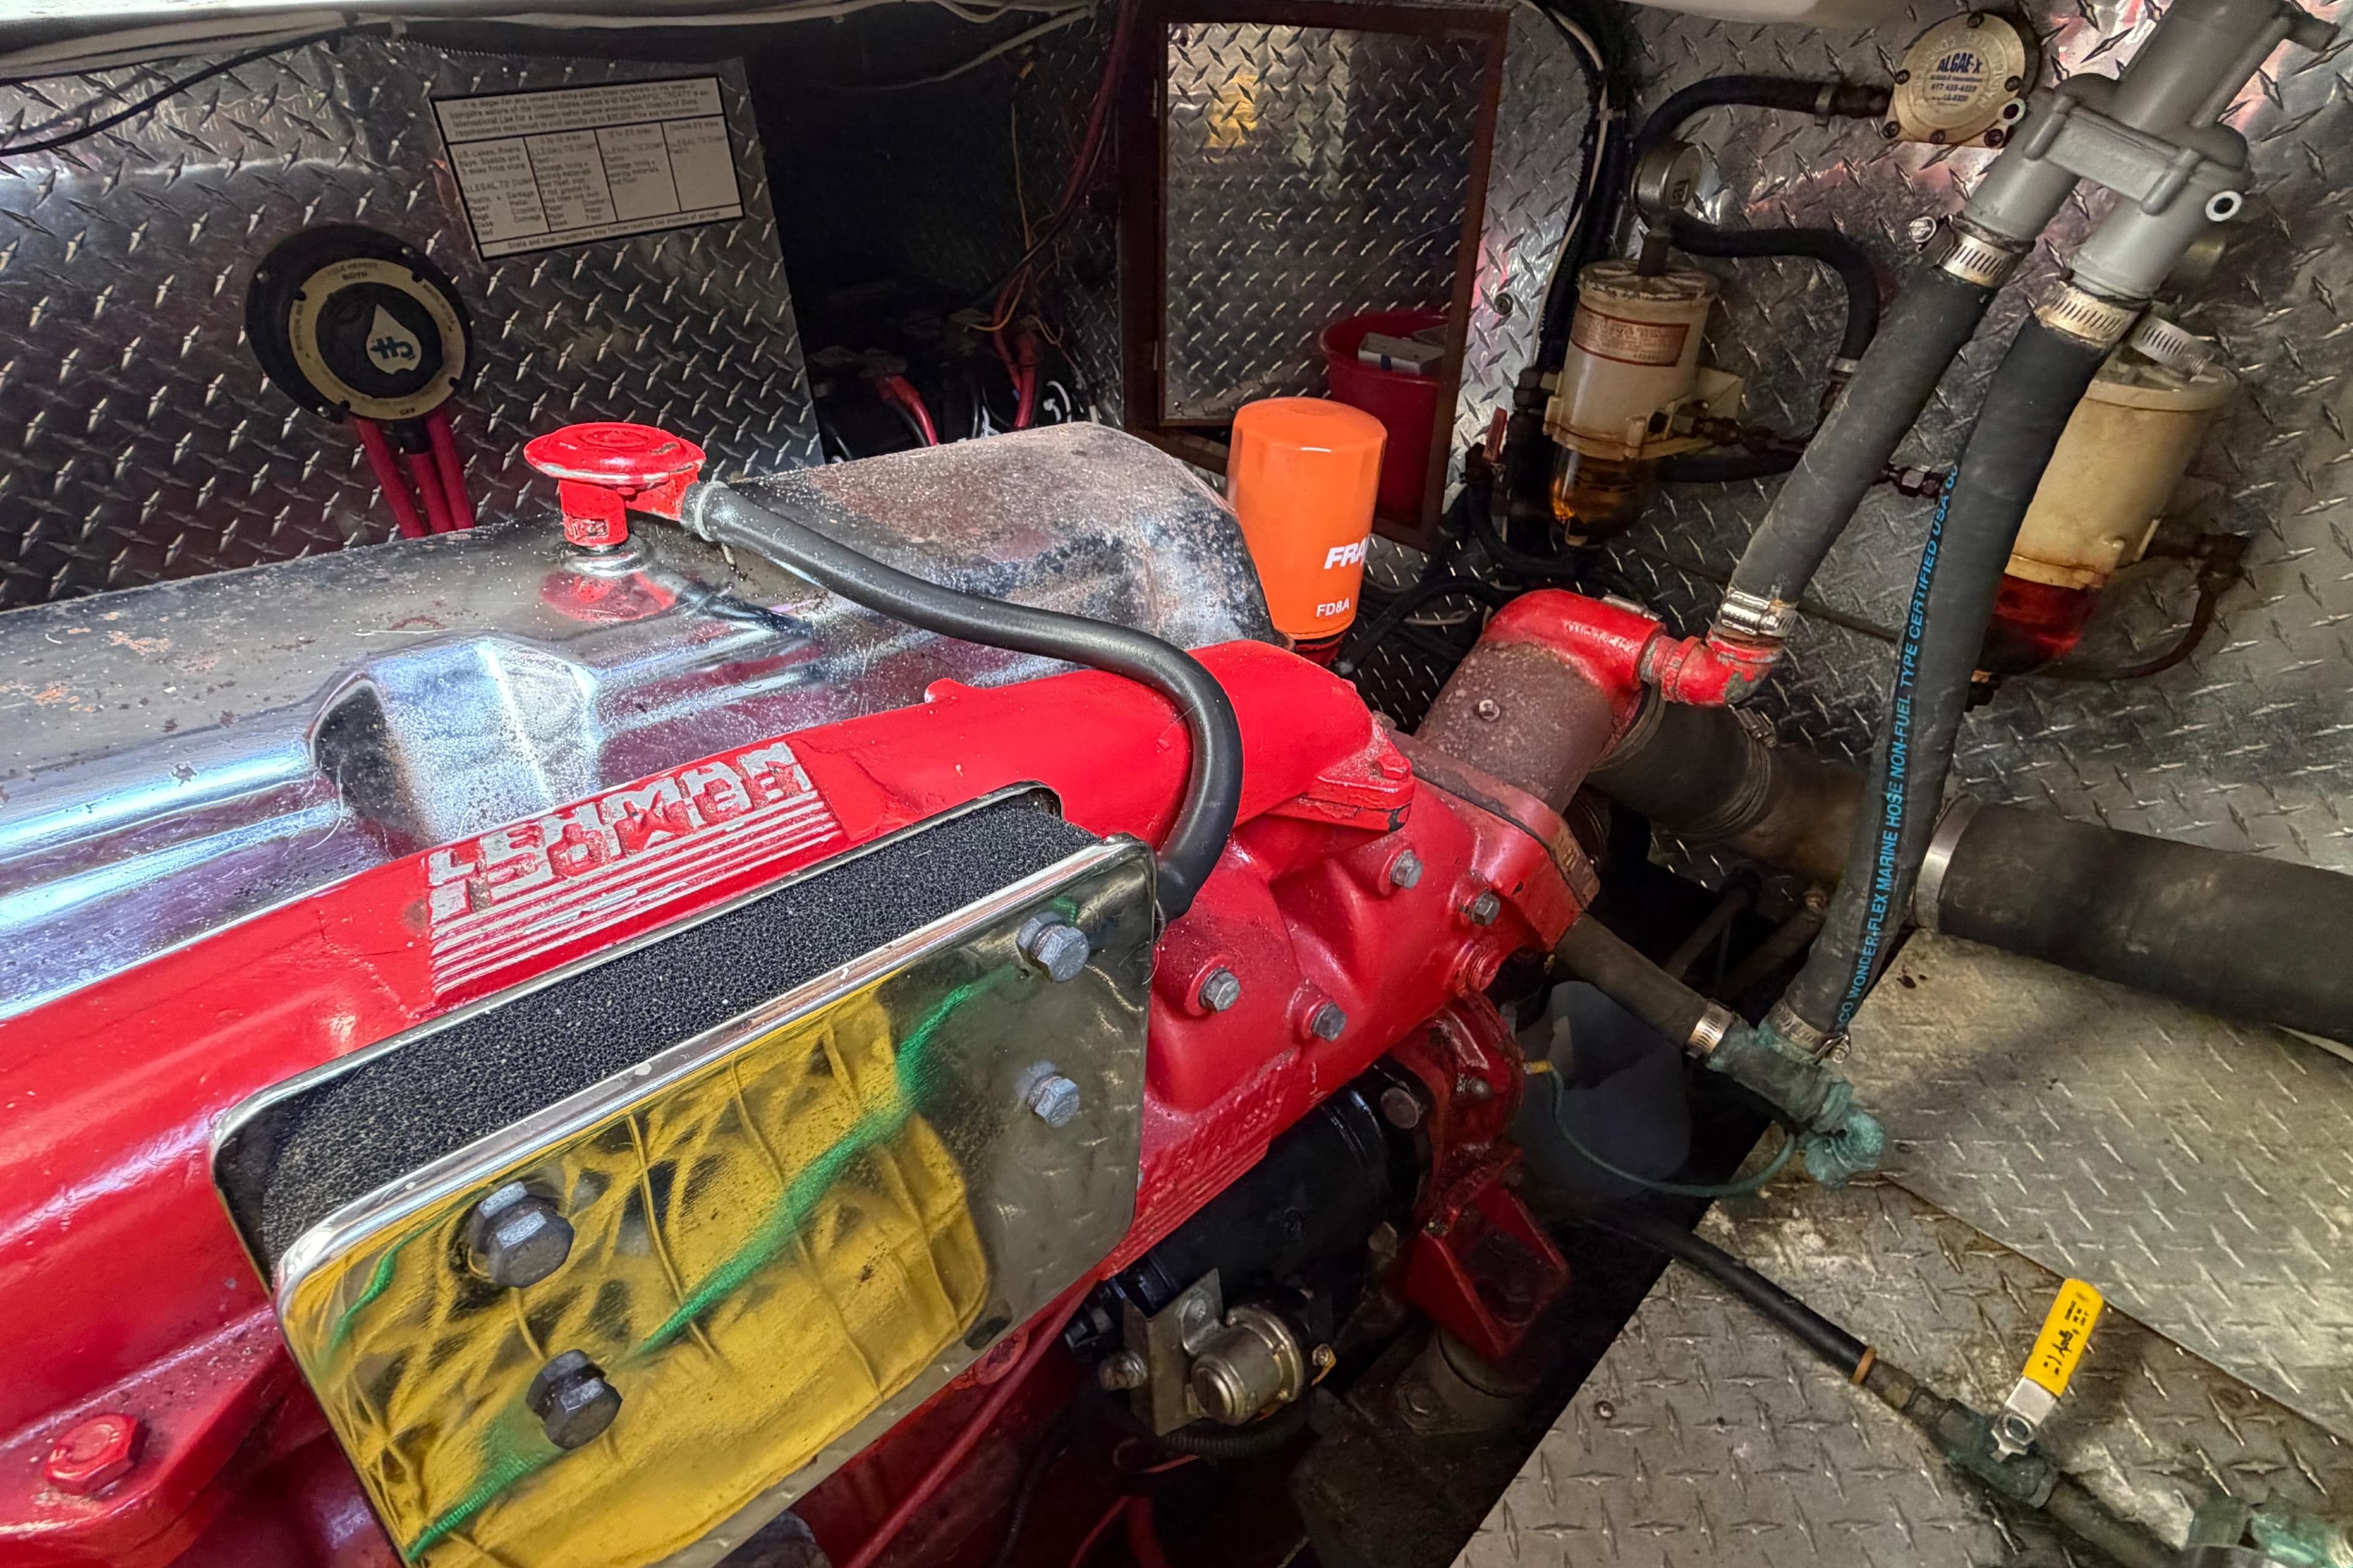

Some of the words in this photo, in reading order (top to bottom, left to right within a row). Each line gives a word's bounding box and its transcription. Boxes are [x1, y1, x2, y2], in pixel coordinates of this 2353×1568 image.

[1936, 52, 1983, 74] ALGAE-X
[1932, 494, 1950, 536] USA
[1324, 537, 1369, 569] FRA
[1316, 597, 1350, 618] FD8A
[1909, 539, 1938, 640] CERTIFIED
[1900, 643, 1919, 689] TYPE
[1890, 694, 1911, 779] NON-FUEL
[1885, 782, 1903, 829] HOSE
[1876, 830, 1898, 891] MARINE
[1847, 893, 1888, 999] WONDER-FLEX
